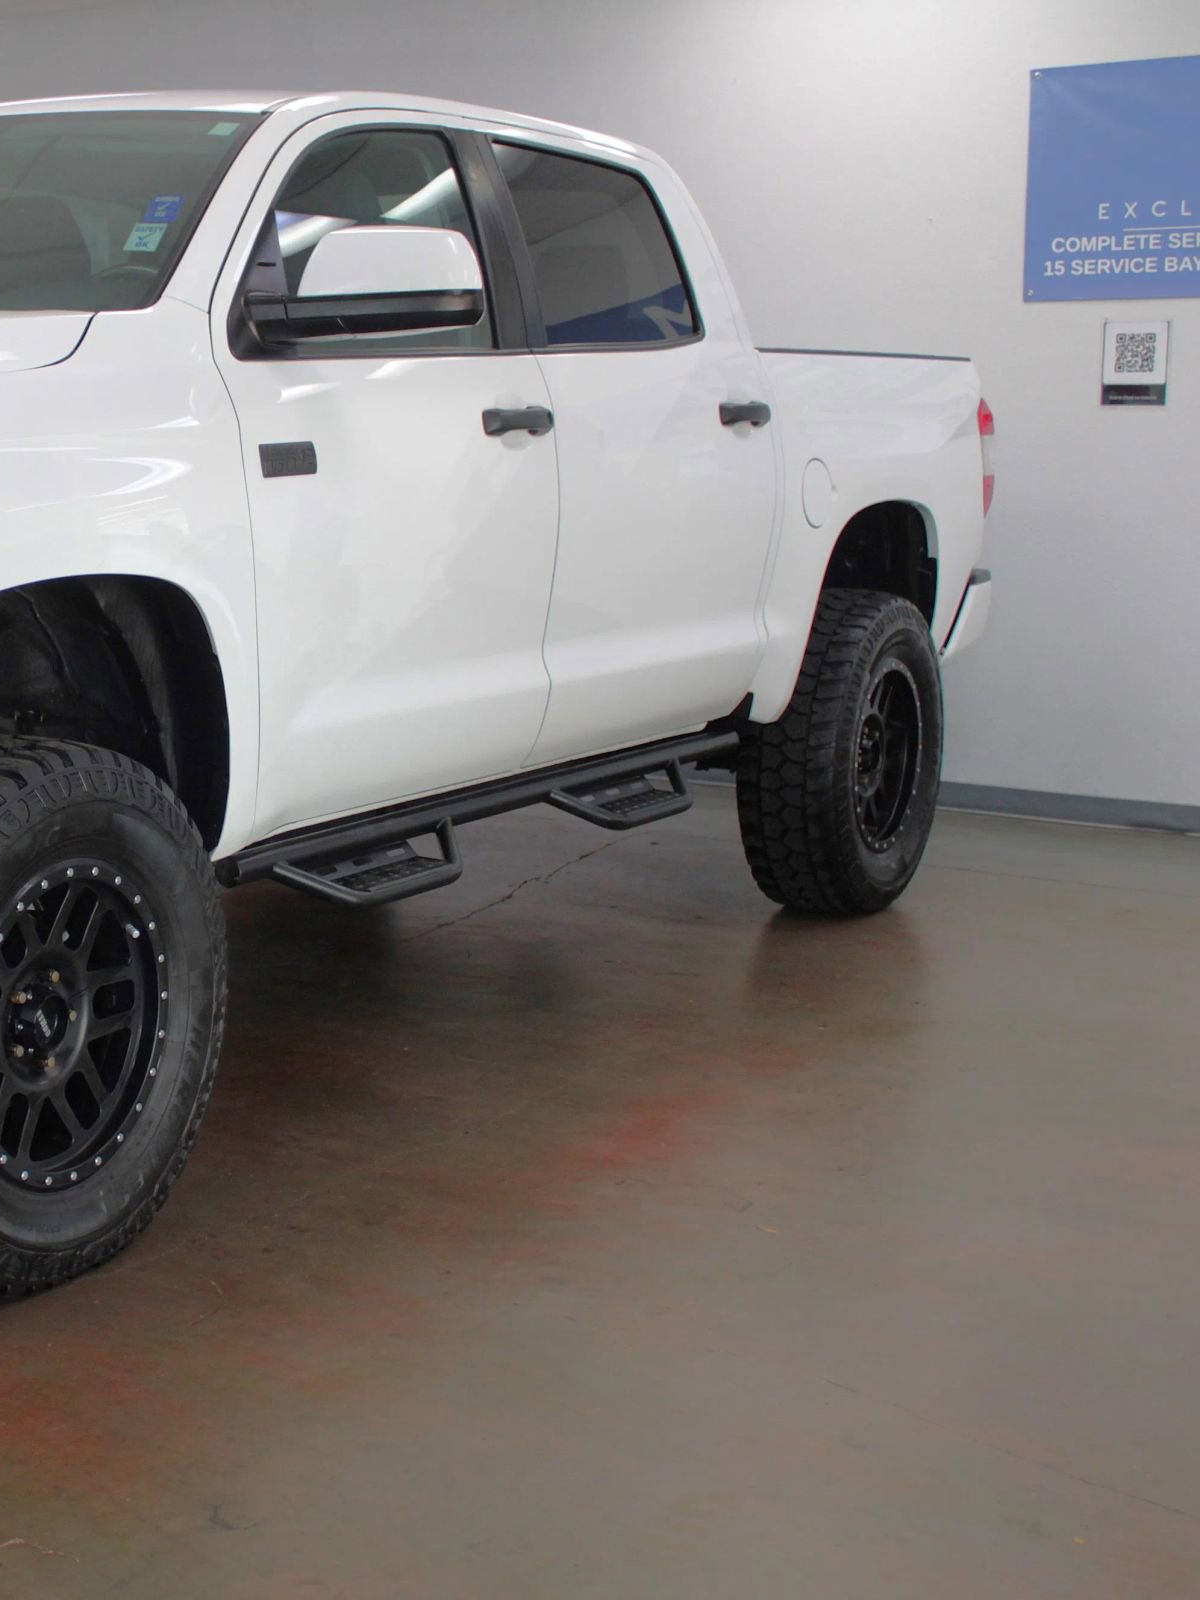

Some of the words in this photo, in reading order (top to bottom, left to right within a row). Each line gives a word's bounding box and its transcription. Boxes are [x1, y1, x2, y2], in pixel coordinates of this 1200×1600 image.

[1098, 200, 1192, 220] EXCL
[1051, 233, 1162, 253] COMPLETE
[1043, 260, 1065, 276] 15
[1071, 257, 1158, 275] SERVICE
